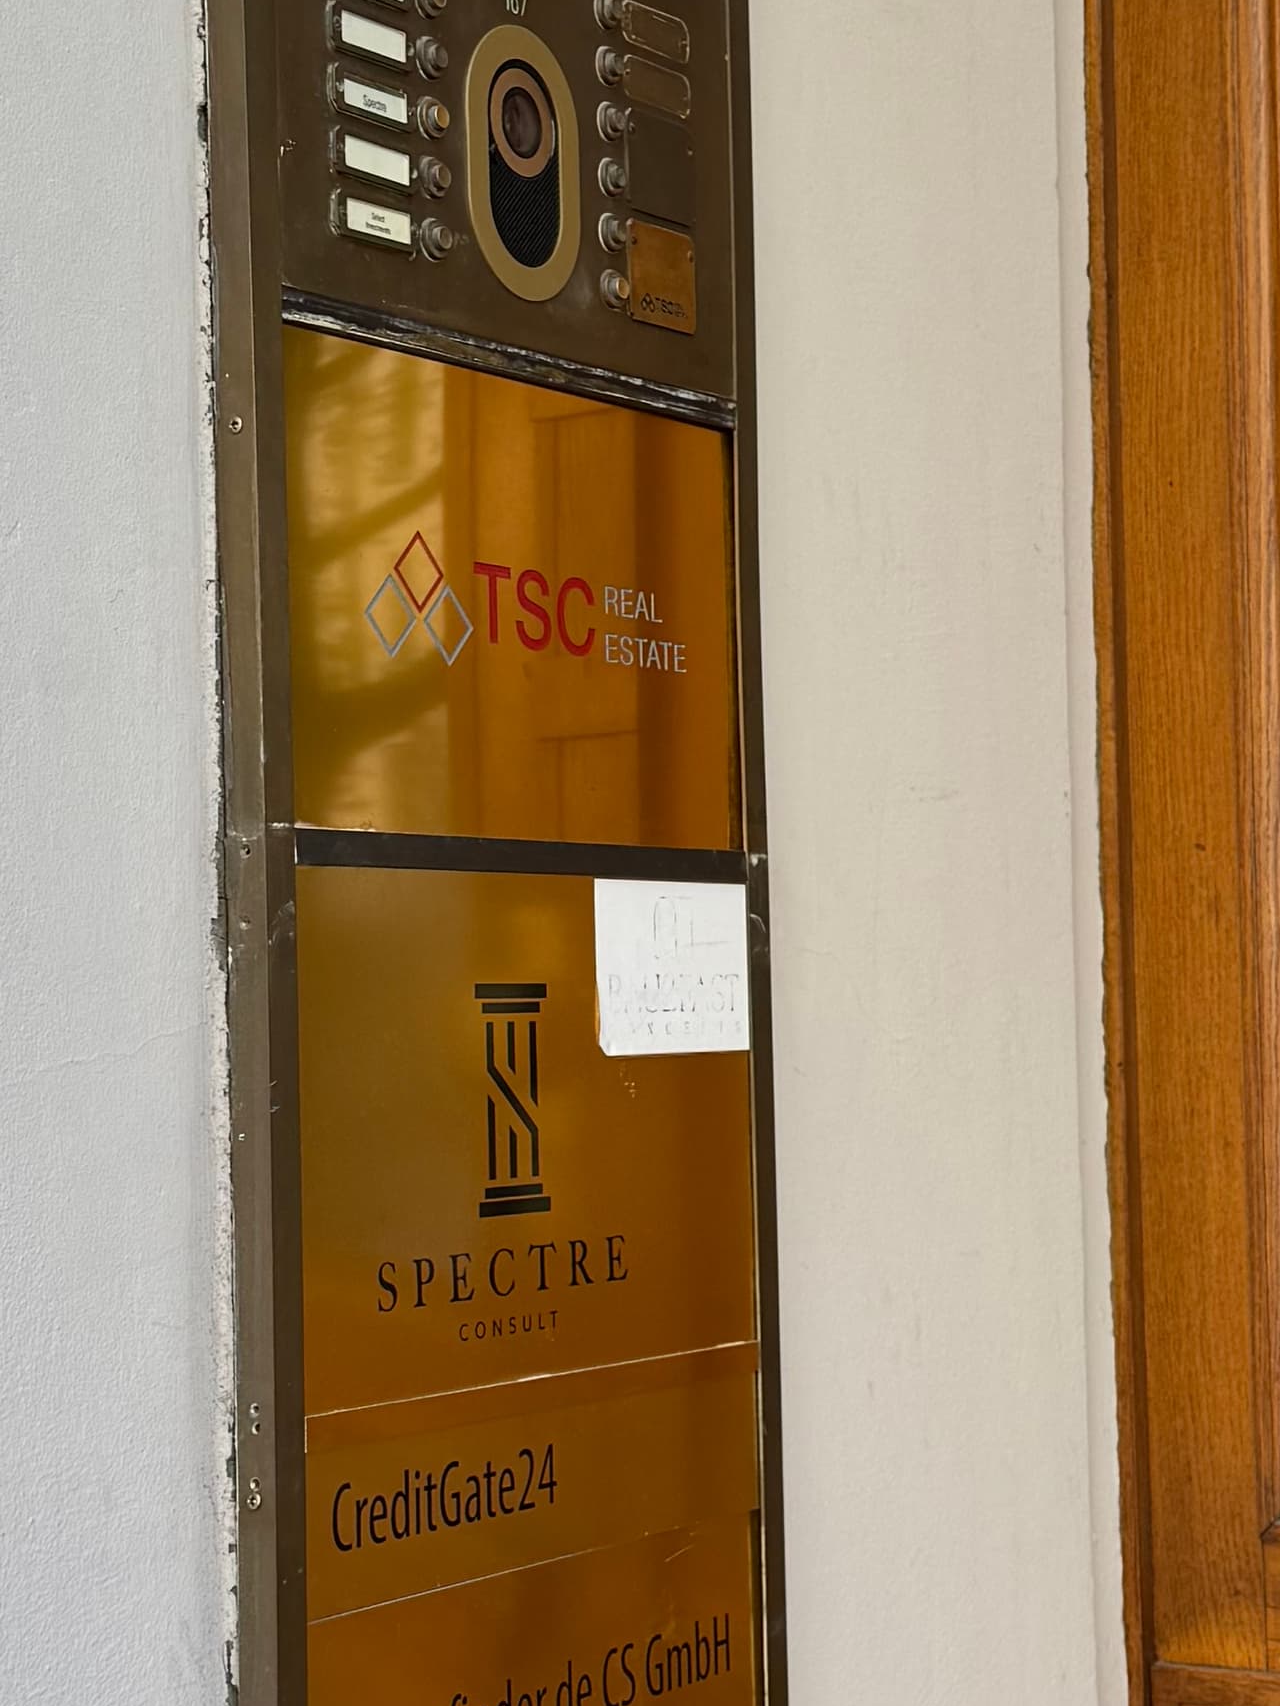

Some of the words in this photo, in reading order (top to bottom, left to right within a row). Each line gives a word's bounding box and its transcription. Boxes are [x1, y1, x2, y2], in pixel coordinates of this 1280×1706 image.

[473, 560, 596, 657] TSC
[603, 585, 664, 625] REAL
[604, 633, 688, 675] ESTATE
[376, 1233, 630, 1313] SPECTRE
[458, 1309, 560, 1342] CONSULT
[331, 1442, 558, 1553] CreditGate24
[645, 1612, 731, 1696] GmbH
